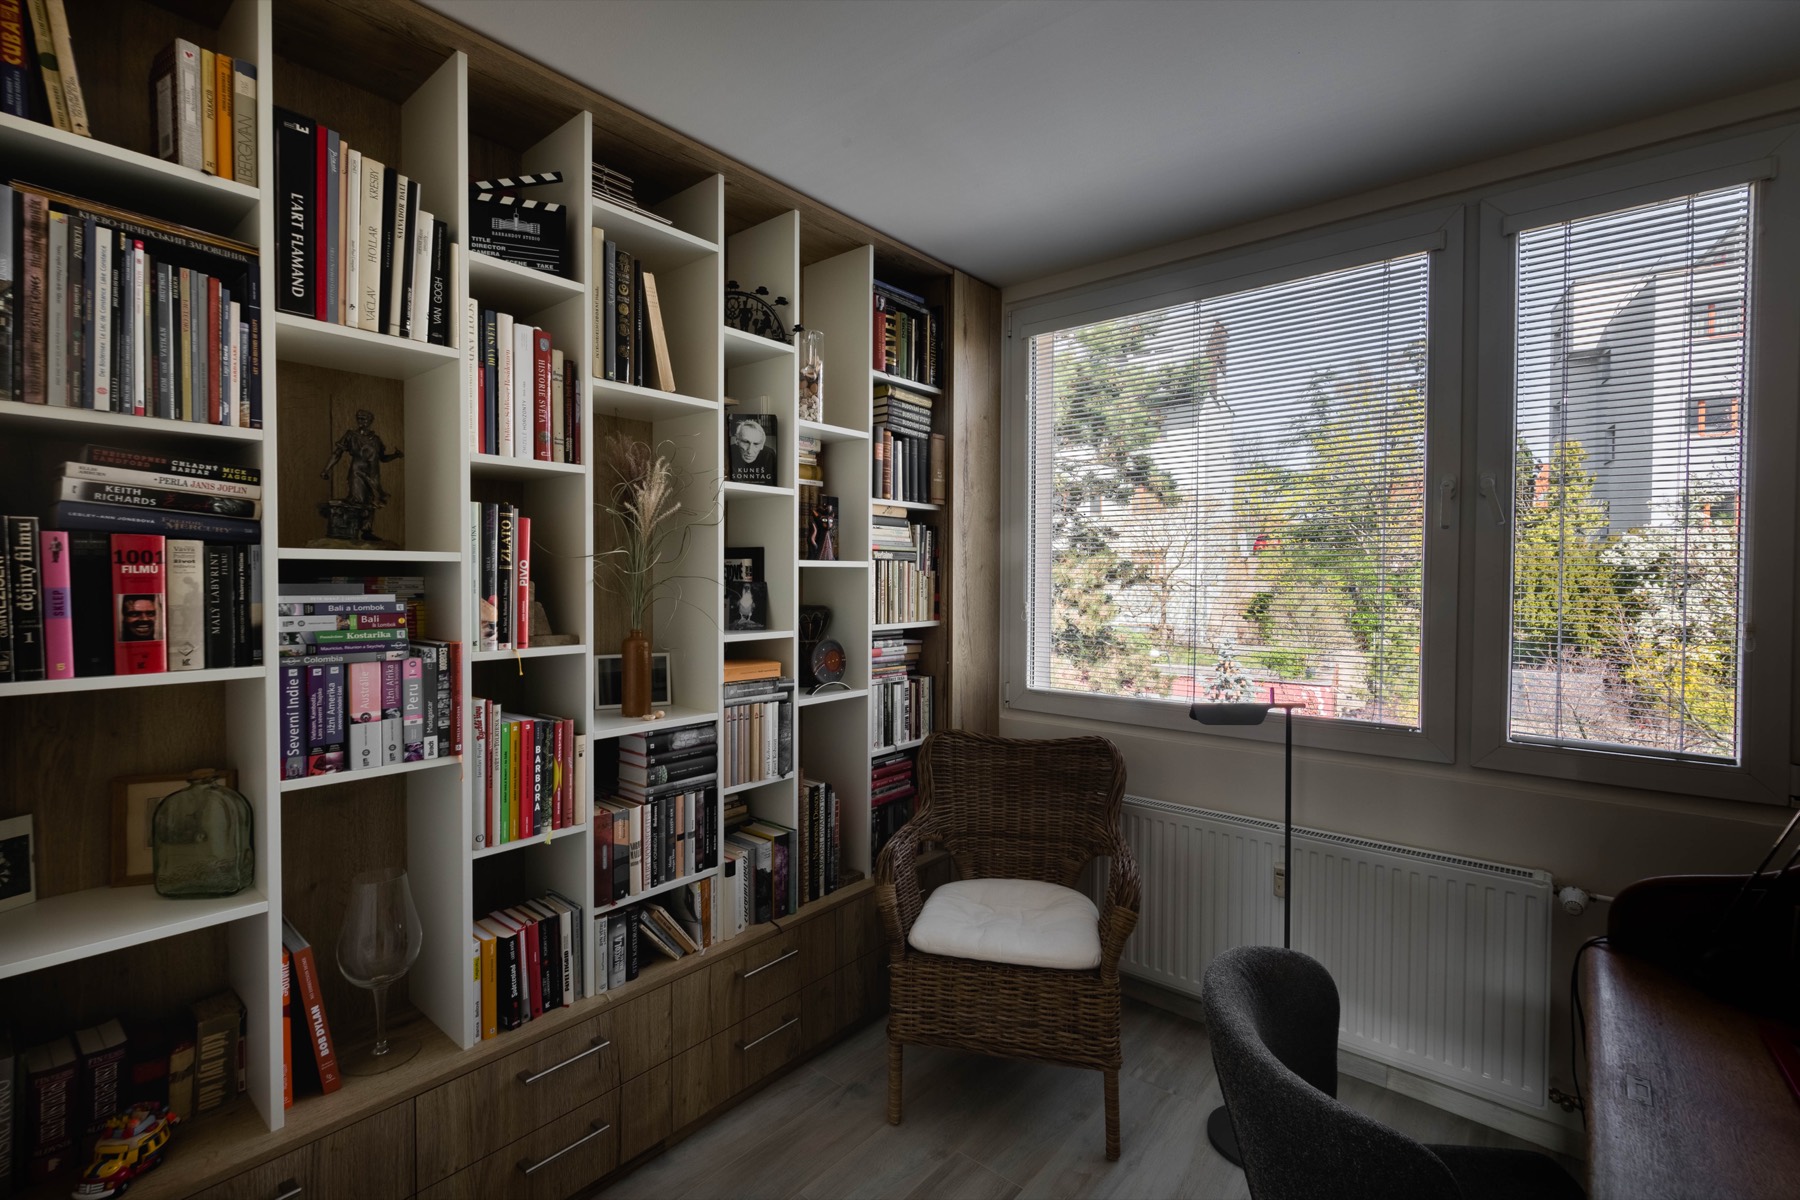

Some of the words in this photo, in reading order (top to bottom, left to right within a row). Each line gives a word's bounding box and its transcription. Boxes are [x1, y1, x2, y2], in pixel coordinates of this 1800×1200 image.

[2, 22, 23, 66] CUBA
[237, 113, 253, 178] BERGMAN
[369, 167, 380, 201] KRESBY
[290, 192, 305, 230] L'ART
[397, 203, 405, 240] SALVADOR
[73, 225, 82, 260] FLORENZ
[367, 226, 378, 264] HOLLAR
[471, 235, 491, 243] TITLE
[471, 242, 506, 251] DIRECTOR
[522, 234, 541, 242] STUDIO
[290, 232, 305, 298] FLAMAND
[536, 262, 554, 270] TAKE
[434, 276, 443, 304] GOGH
[31, 304, 42, 328] SUNT
[366, 286, 377, 322] VÁCLAV
[433, 306, 442, 325] VAN
[159, 326, 168, 358] VATIKAN
[487, 322, 496, 345] SVĚTA
[487, 348, 496, 367] DIVY
[538, 359, 546, 399] HISTORIE
[538, 398, 546, 423] SVĚTA
[171, 459, 219, 472] CHLADNÝ
[171, 466, 211, 476] BARBAR
[221, 472, 259, 483] JAGGER
[222, 466, 247, 475] MICK
[737, 466, 765, 474] KUNEŠ
[105, 485, 142, 496] KEITH
[158, 477, 188, 488] PERLA
[190, 480, 216, 491] JANIS
[217, 482, 248, 495] JOPLIN
[93, 493, 157, 507] RICHARDS
[13, 521, 32, 562] filmu
[500, 519, 512, 567] ZLATO
[113, 549, 164, 565] 1001
[121, 562, 159, 574] FILMŮ
[221, 553, 229, 575] FILMU
[210, 552, 220, 605] LABYRINT
[519, 559, 529, 587] PIVO
[15, 563, 37, 611] dějiny
[52, 590, 64, 617] SKLEP
[328, 604, 344, 612] Bali
[353, 604, 385, 612] Lombok
[210, 606, 221, 635] MALÝ
[361, 615, 380, 623] Bali
[346, 631, 392, 640] Kostarika
[303, 655, 344, 664] Colombia
[386, 664, 395, 686] Afrika
[286, 676, 299, 709] Indie
[326, 682, 336, 715] Amerika
[360, 671, 370, 709] Austrálie
[386, 688, 396, 705] Jižní
[406, 683, 419, 711] Peru
[287, 710, 300, 756] Severní
[327, 717, 336, 735] Jižní
[310, 1004, 325, 1038] DYLAN
[316, 1035, 330, 1057] BOB
